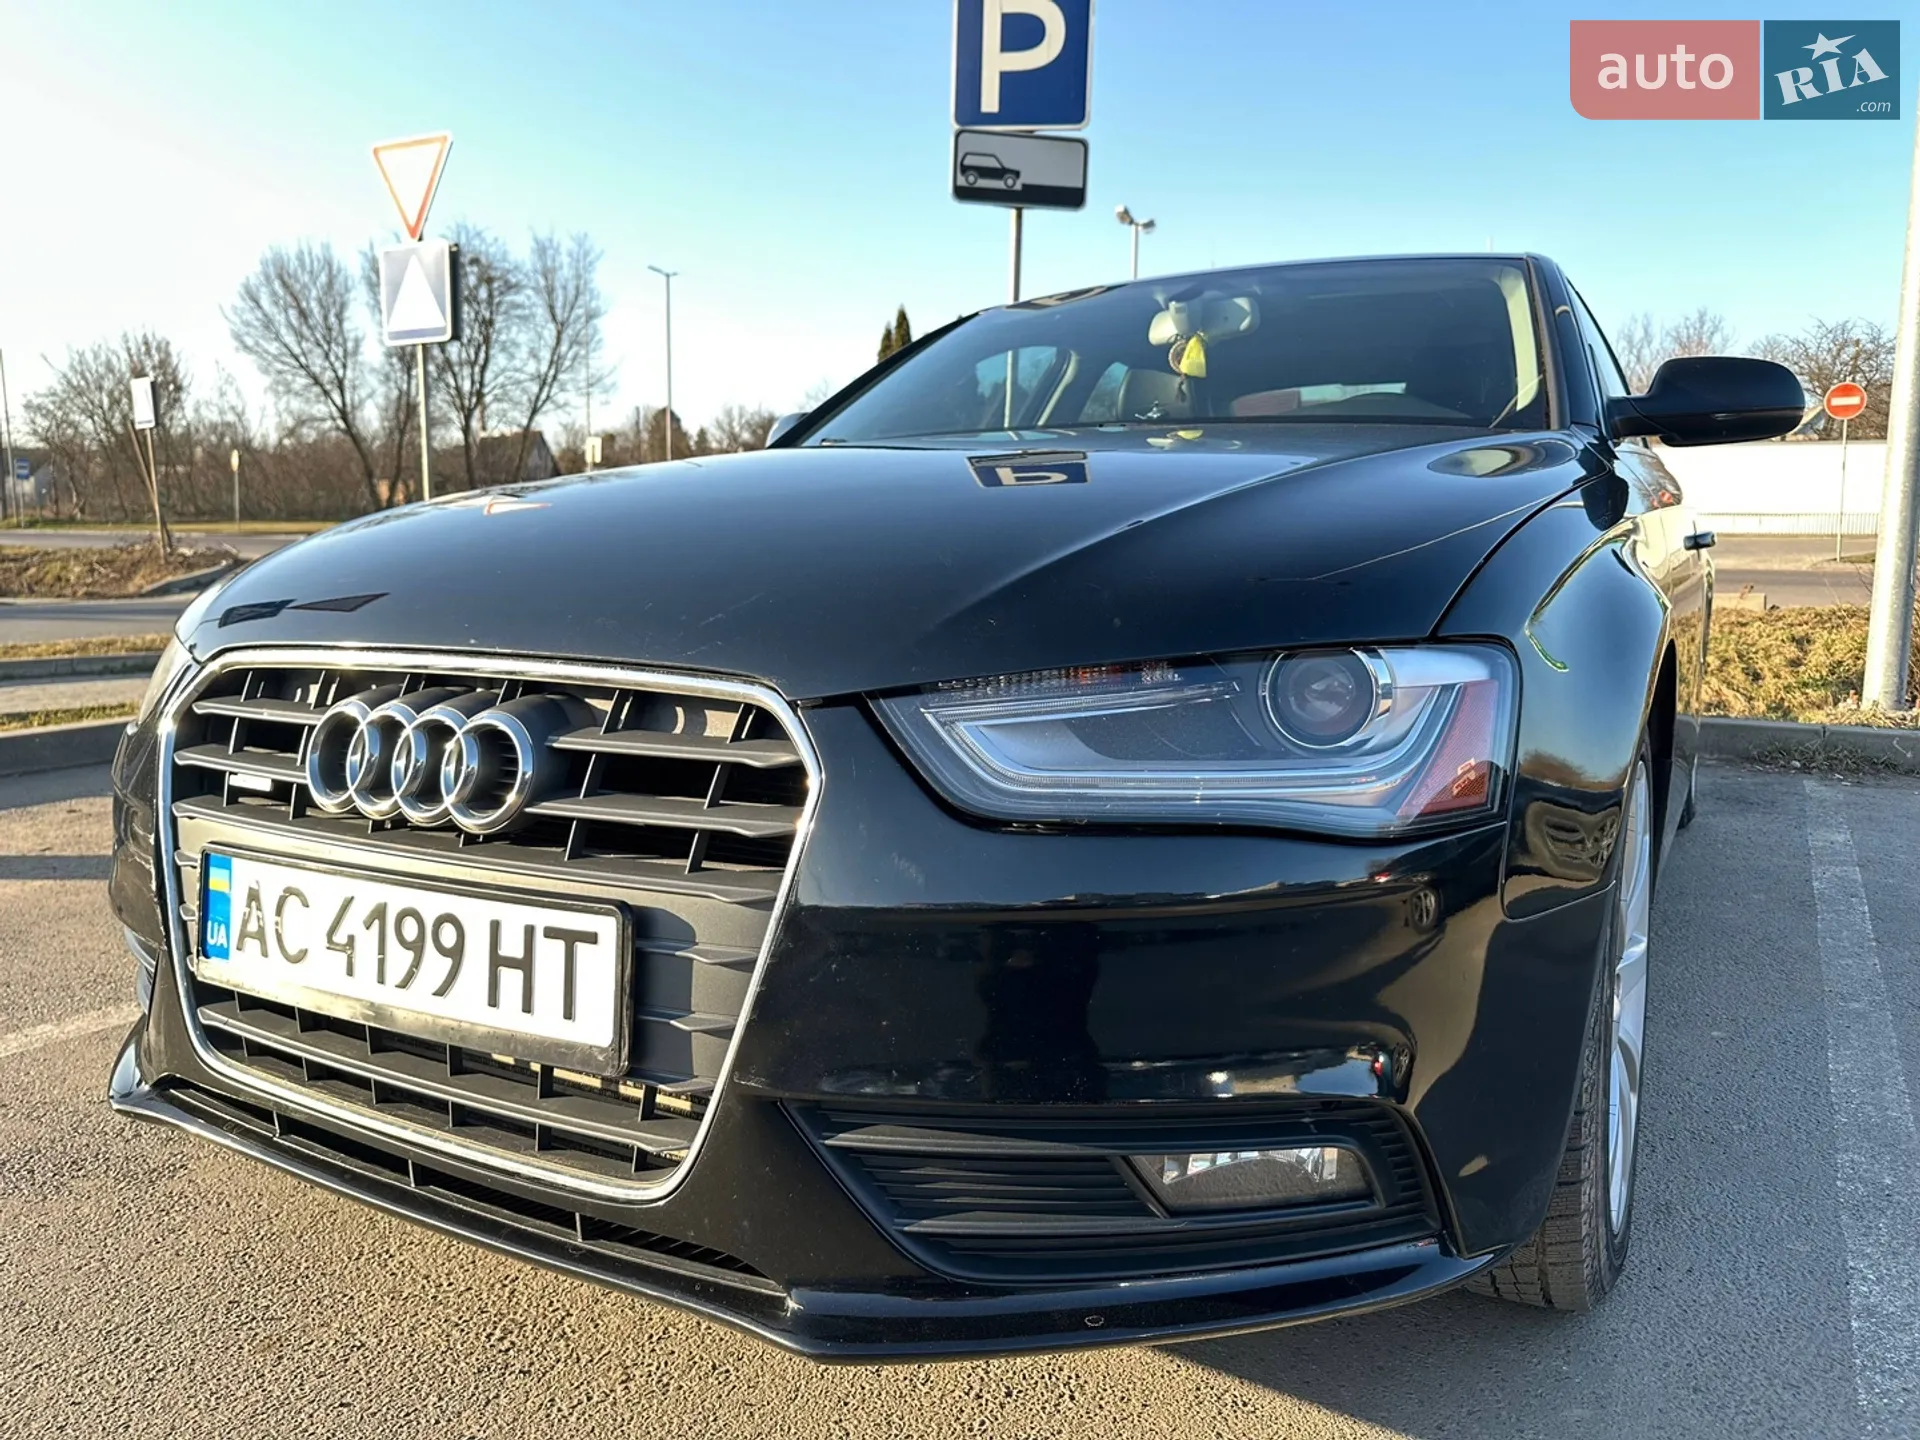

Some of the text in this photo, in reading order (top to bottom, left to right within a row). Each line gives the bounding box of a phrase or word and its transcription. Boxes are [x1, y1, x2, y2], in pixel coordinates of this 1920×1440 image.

[980, 0, 1067, 113] P
[206, 920, 229, 949] UA
[235, 880, 598, 1022] AC 4199 HT
